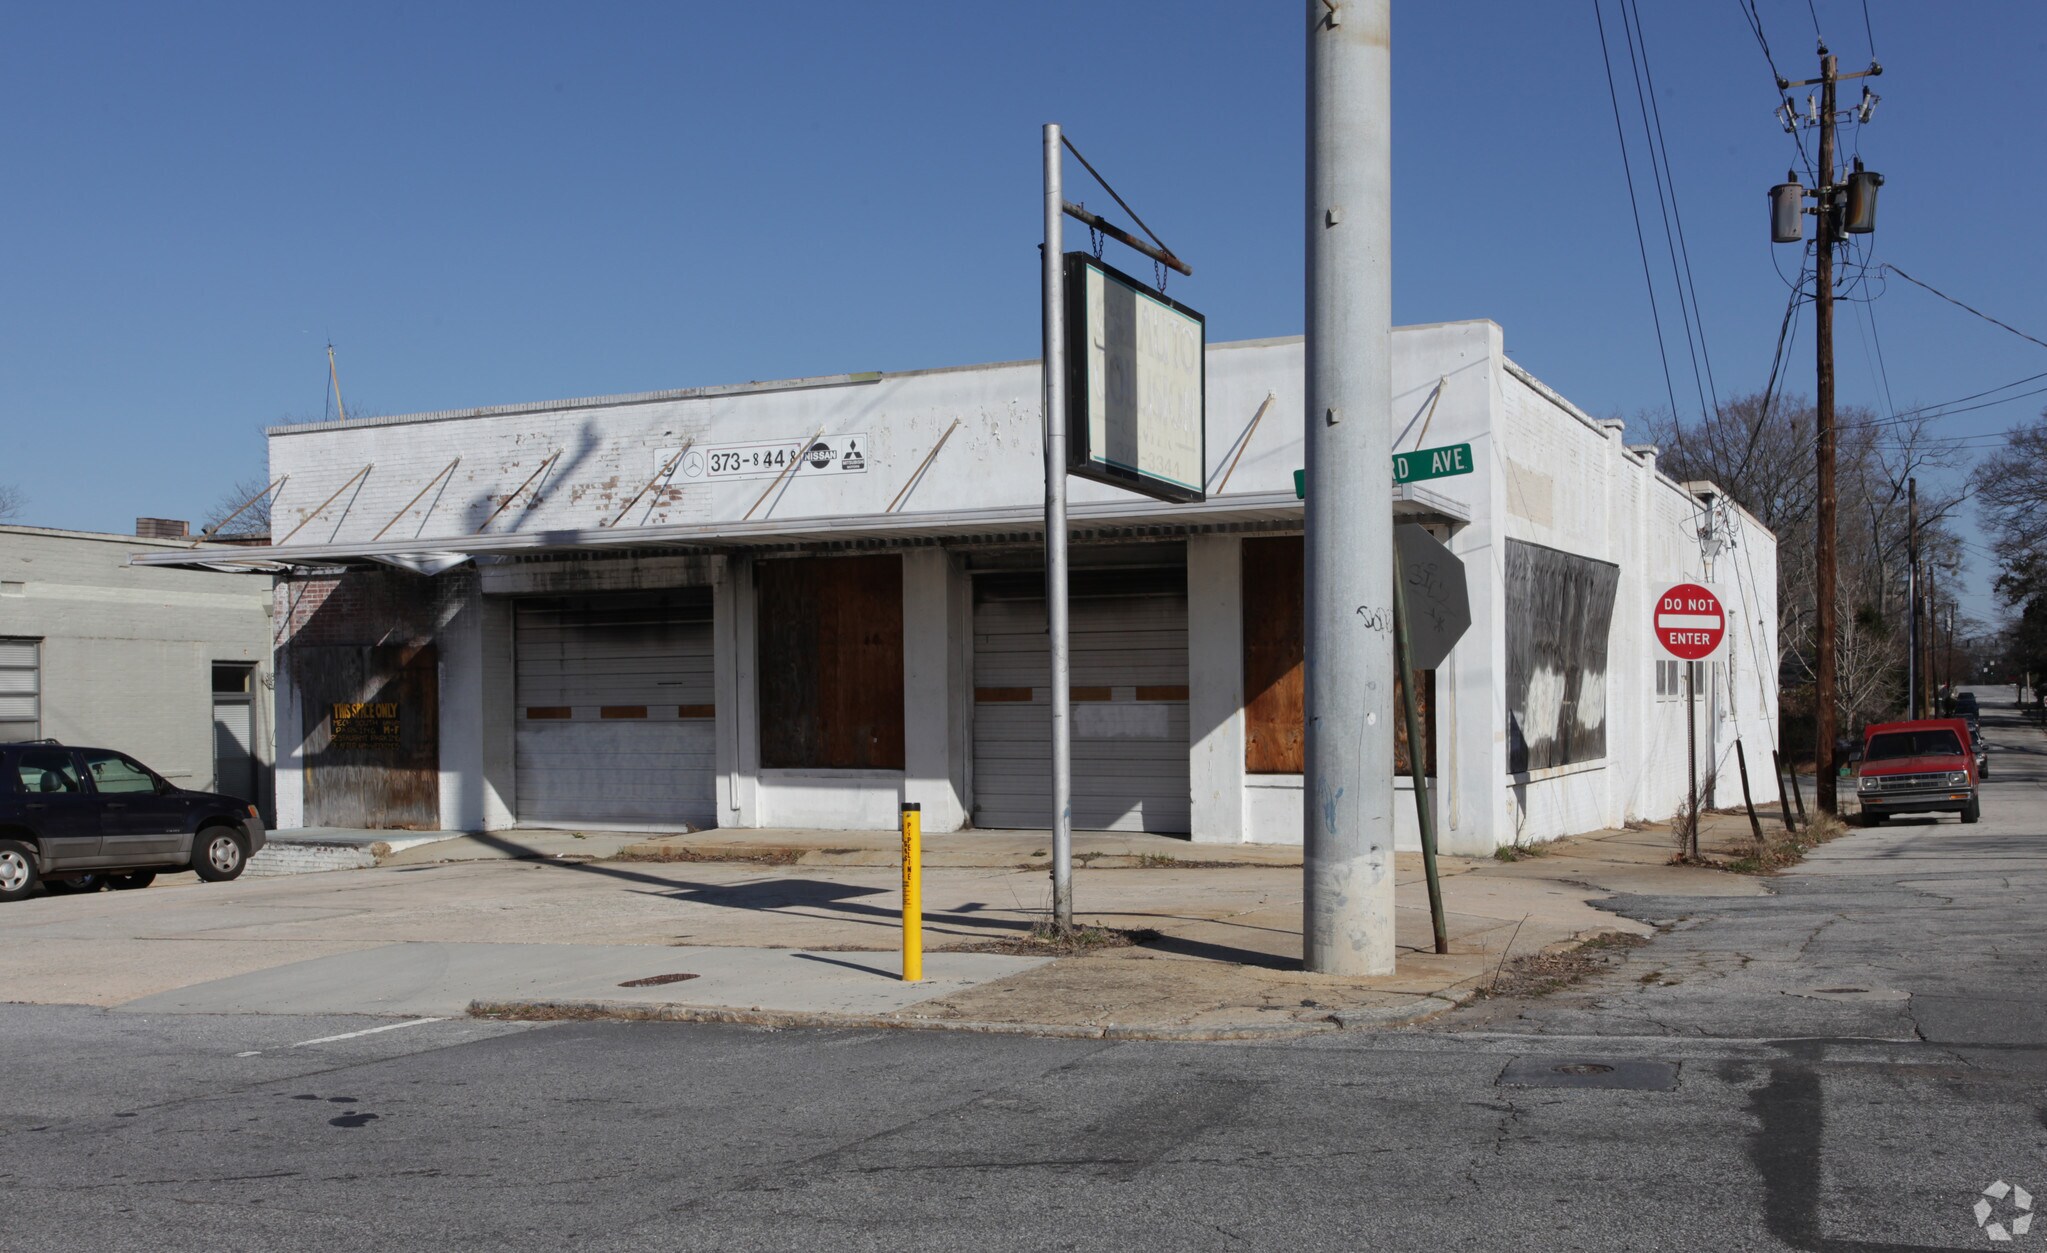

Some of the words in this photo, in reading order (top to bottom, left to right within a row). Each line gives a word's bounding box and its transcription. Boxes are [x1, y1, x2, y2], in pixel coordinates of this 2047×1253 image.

[804, 450, 836, 461] NISSAN
[1664, 598, 1682, 611] DO
[1688, 598, 1714, 611] NOT
[1669, 632, 1710, 645] ENTER
[333, 703, 351, 719] THIS
[351, 703, 375, 719] SPACE
[375, 703, 398, 719] ONLY
